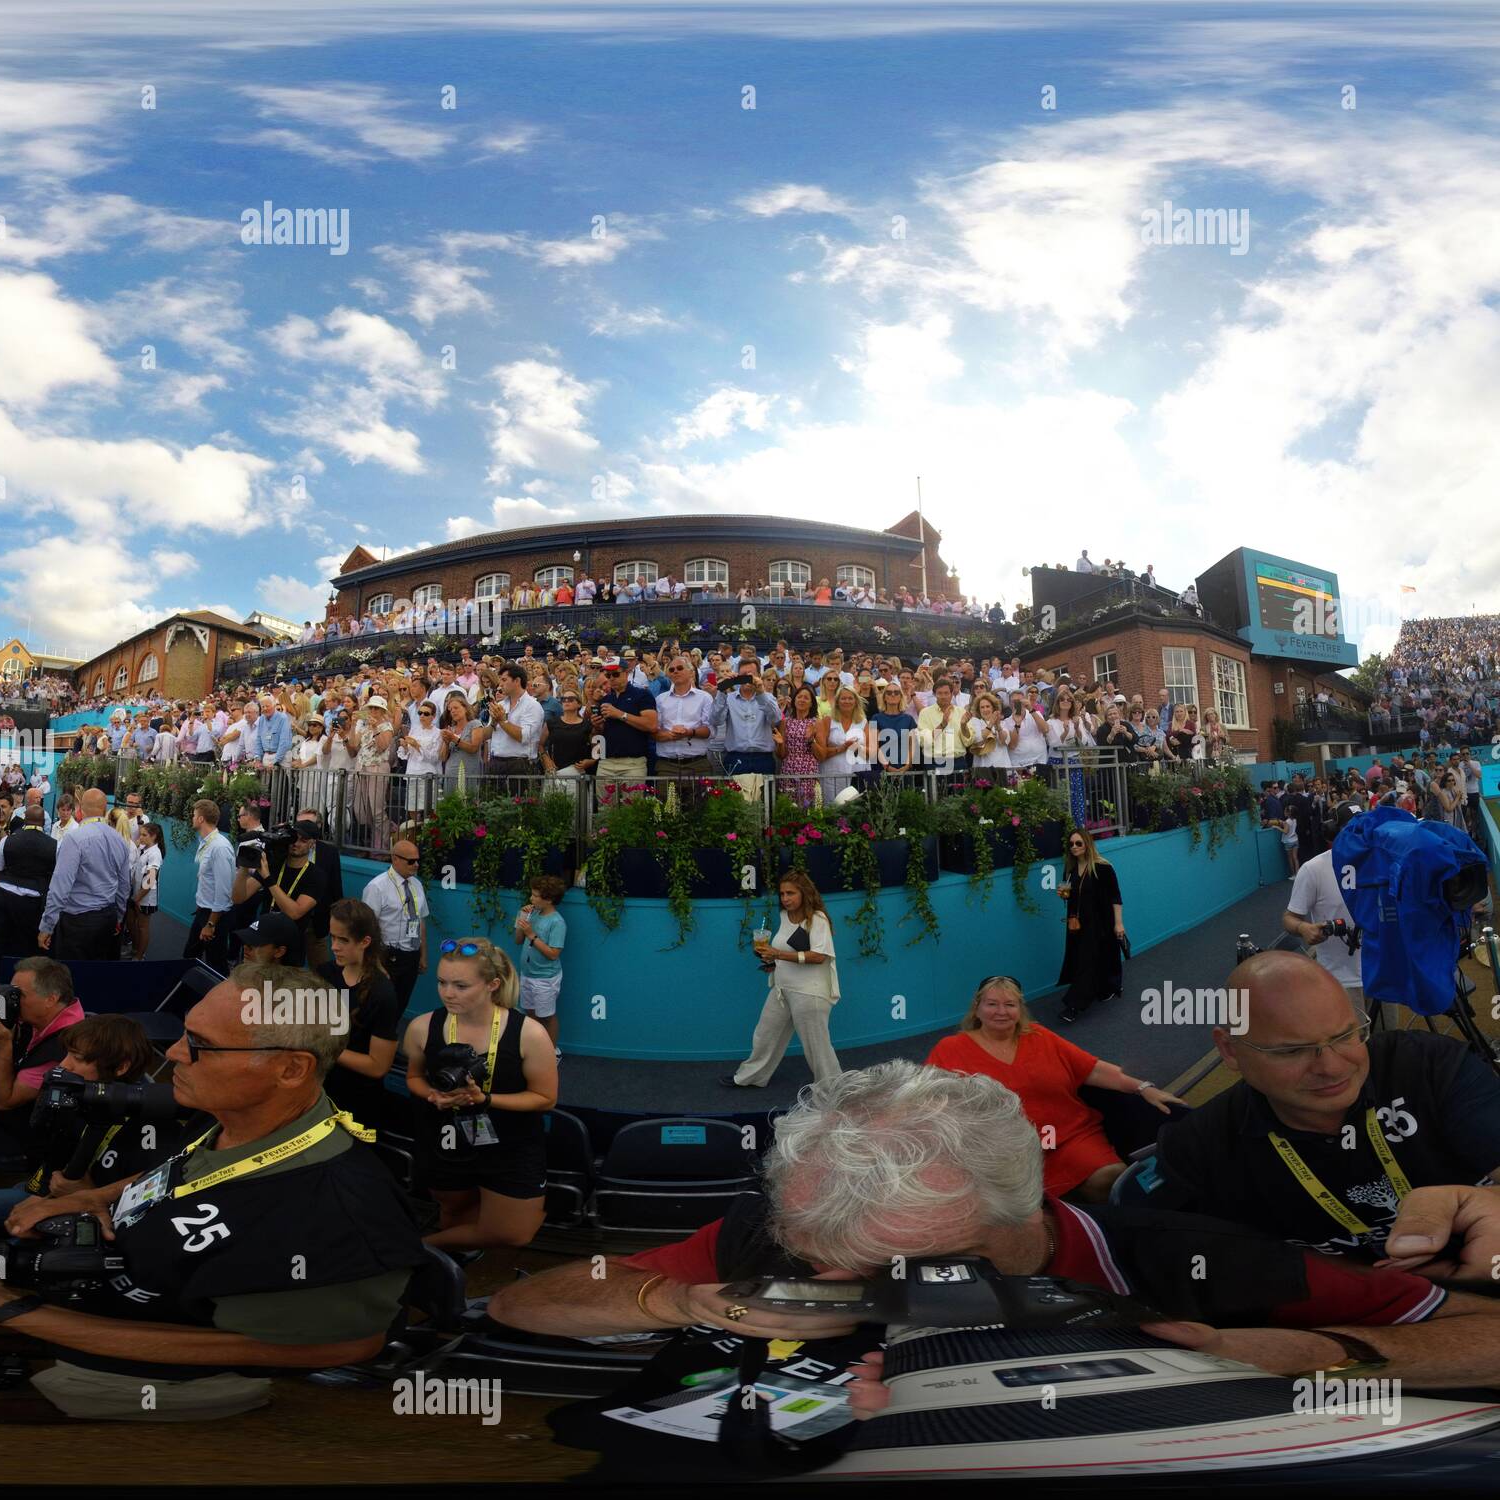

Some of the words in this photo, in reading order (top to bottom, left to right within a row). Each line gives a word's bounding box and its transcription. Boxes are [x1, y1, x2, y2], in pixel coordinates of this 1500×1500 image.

[1290, 637, 1340, 654] FEVER-TREE
[1376, 1097, 1418, 1143] 35
[264, 1134, 312, 1159] FEVER-TREE
[102, 1150, 118, 1168] 6
[198, 1166, 236, 1185] FEVER-TREE
[170, 1203, 231, 1252] 25
